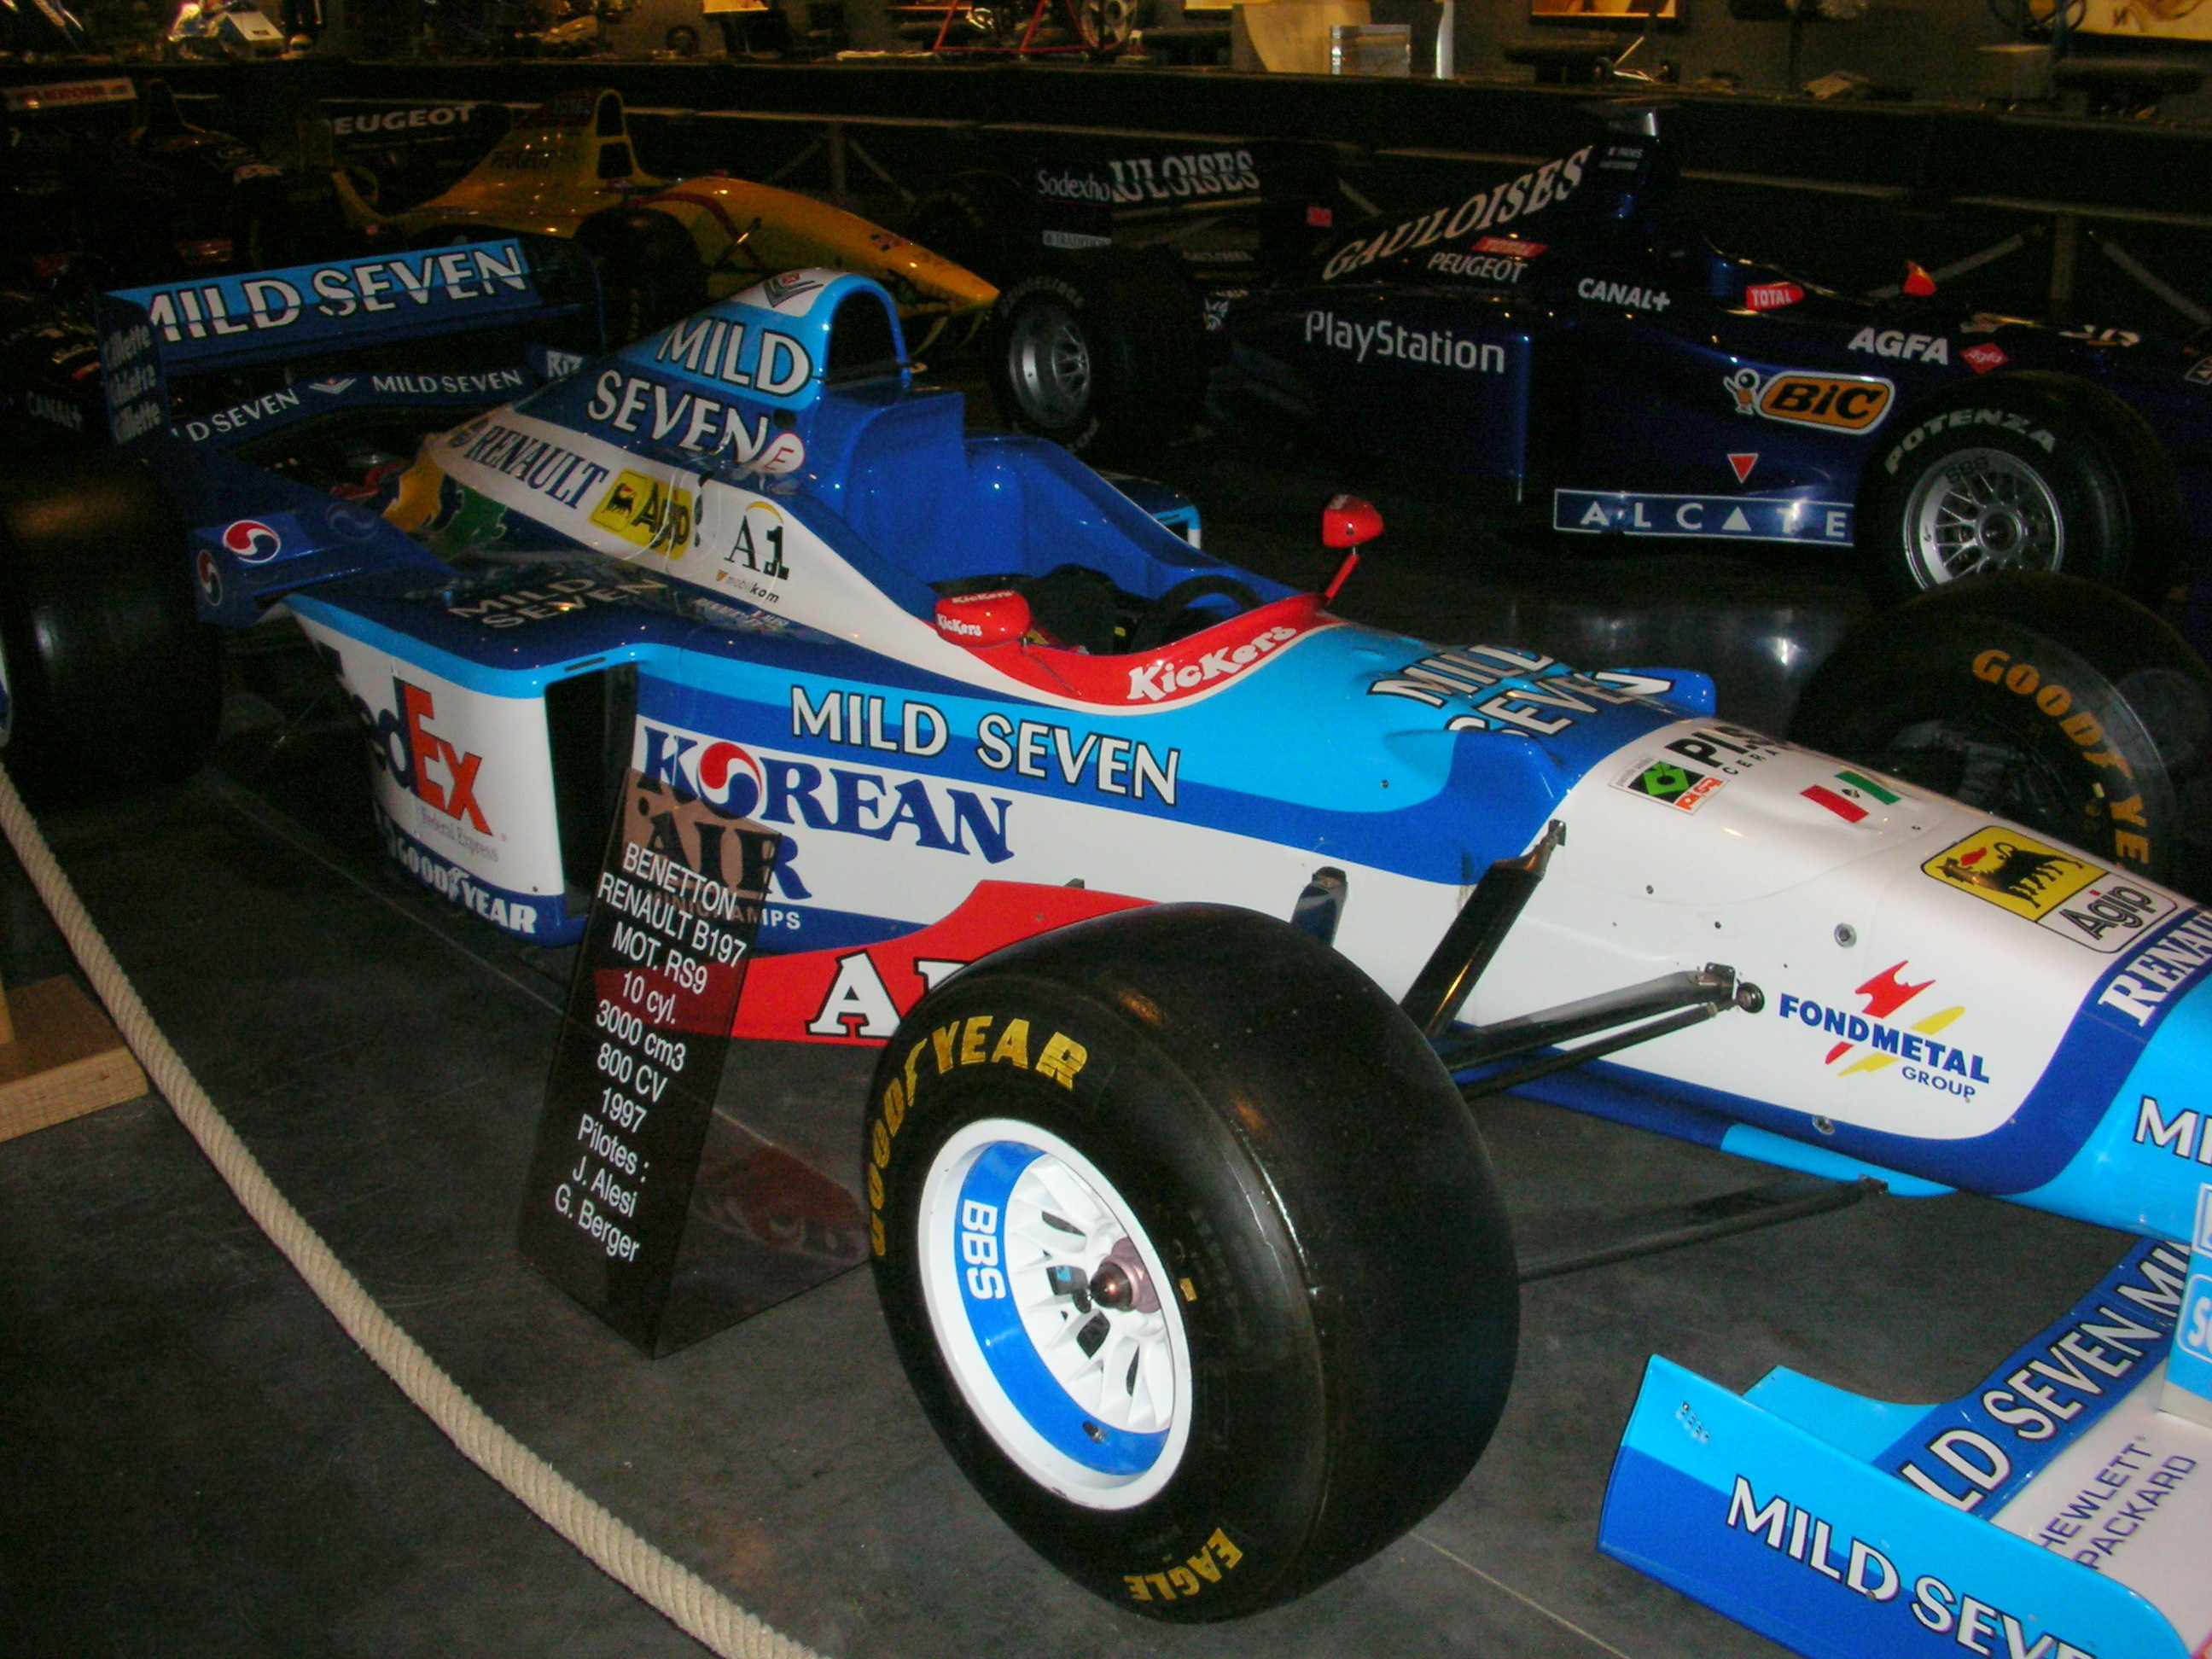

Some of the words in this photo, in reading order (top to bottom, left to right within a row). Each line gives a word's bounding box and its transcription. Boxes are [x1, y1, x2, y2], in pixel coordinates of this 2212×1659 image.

[1036, 170, 1109, 202] Sodexho
[1323, 145, 1595, 281] GAULOISES
[311, 244, 527, 317] SEVEN
[1427, 252, 1528, 284] PEUGEOT
[1578, 277, 1671, 312] CANAL+
[1752, 280, 1793, 308] TOTAL
[655, 317, 812, 397] MILD
[1305, 311, 1505, 373] PlayStation
[1847, 326, 1949, 365] AGFA
[211, 387, 300, 433] SEVEN
[371, 375, 439, 394] MILD
[443, 369, 523, 393] SEVEN
[587, 368, 769, 463] SEVEN
[463, 425, 610, 509] RENAULT
[1884, 408, 2058, 475] POTENZA
[724, 515, 790, 581] A1
[446, 579, 597, 619] MILD
[480, 579, 669, 628] SEVEN
[791, 684, 950, 758] MILD
[977, 712, 1181, 806] SEVEN
[642, 727, 1016, 864] KOREAN
[623, 841, 737, 922] BENETTON
[2058, 886, 2157, 940] Agip
[597, 871, 692, 940] RENAULT
[691, 920, 748, 969] B197
[611, 921, 661, 971] MOT.
[663, 948, 708, 996] RS9
[622, 970, 645, 1004] 10
[646, 989, 677, 1025] cyl.
[596, 998, 643, 1047] 3000
[643, 1032, 686, 1073] cm3
[1778, 992, 1990, 1084] FONDMETAL
[597, 1042, 633, 1084] 800
[635, 1064, 668, 1103] CV
[1901, 1065, 1976, 1099] GROUP
[577, 1113, 638, 1176] Pilotes
[600, 1086, 648, 1133] 1997
[572, 1155, 588, 1185] J.
[590, 1167, 637, 1219] Alesi
[554, 1183, 573, 1220] G.
[577, 1198, 641, 1263] Berger
[961, 1199, 1007, 1301] BBS
[1980, 1306, 2164, 1442] SEVEN
[2038, 1442, 2153, 1548] HEWLETT
[2072, 1454, 2197, 1571] PACKARD
[1123, 1526, 1245, 1603] EAGLE
[1726, 1473, 1901, 1604] MILD
